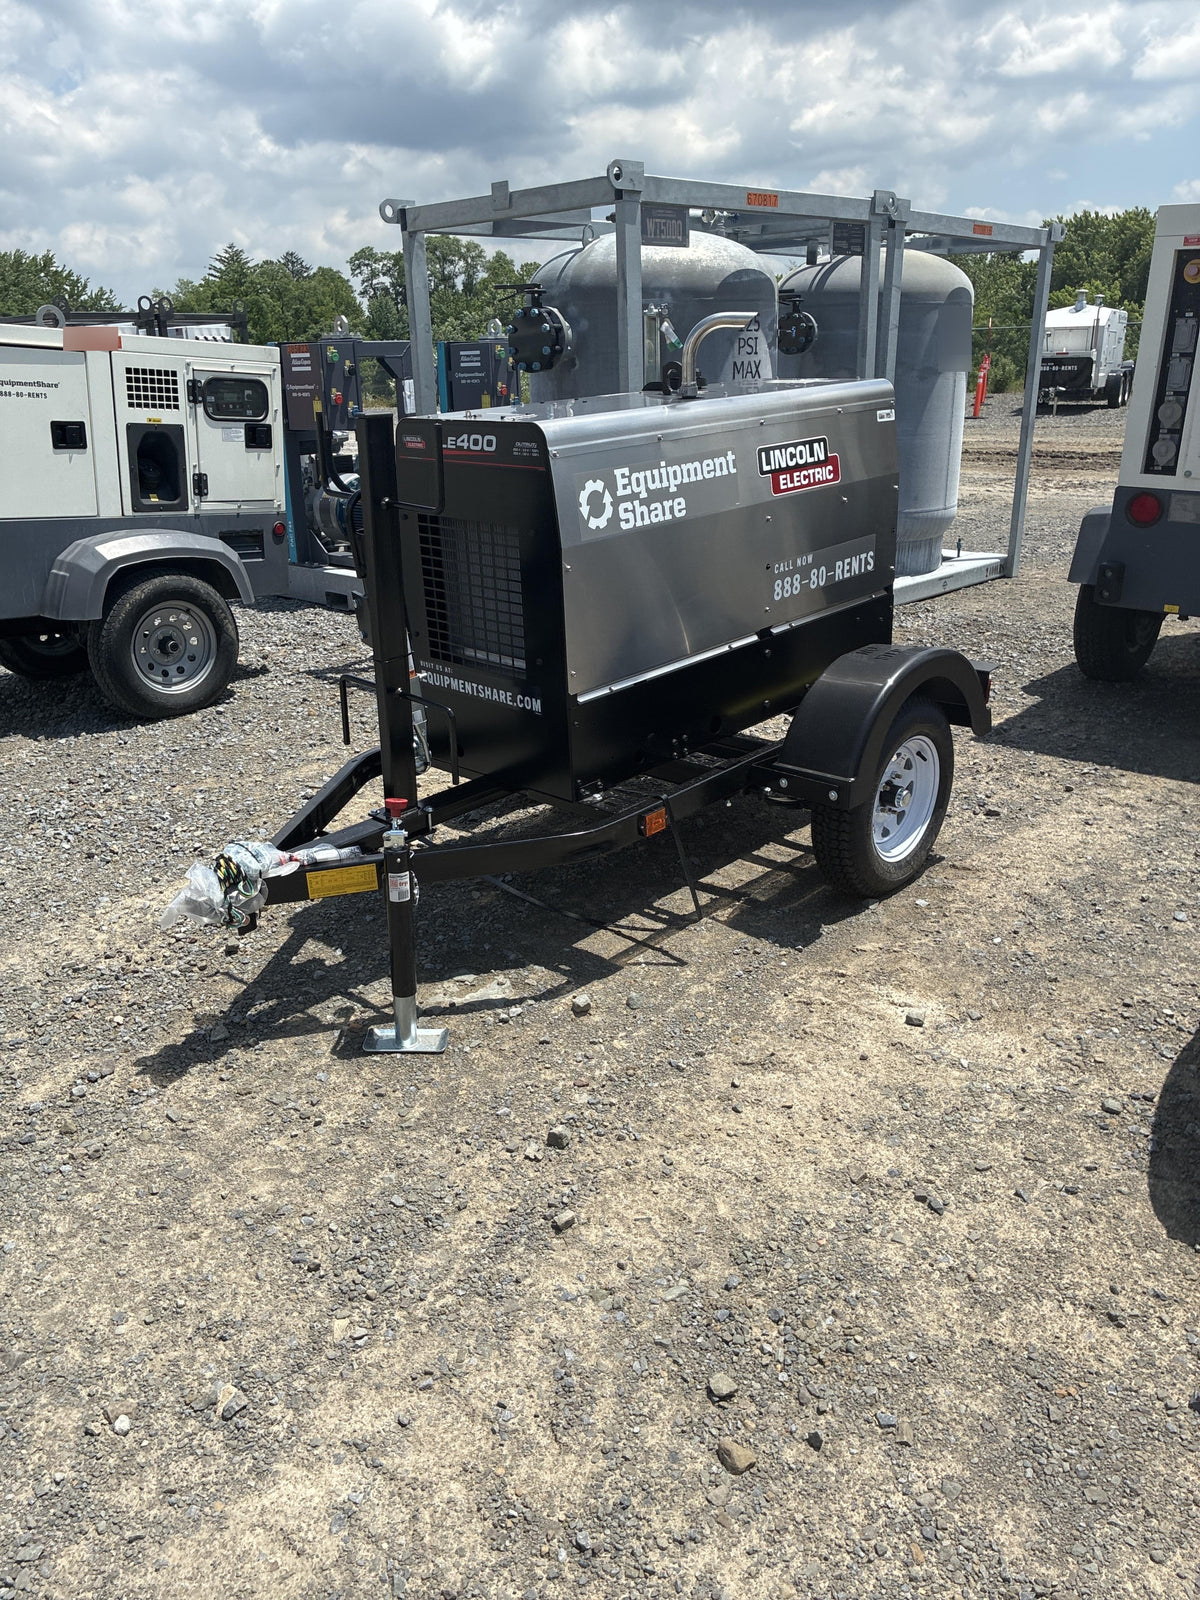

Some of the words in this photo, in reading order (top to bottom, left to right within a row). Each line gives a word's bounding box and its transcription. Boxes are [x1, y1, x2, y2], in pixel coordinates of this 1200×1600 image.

[747, 192, 778, 207] 670817
[737, 336, 758, 355] PSI
[732, 360, 761, 379] MAX
[0, 390, 48, 399] 888-80-RENTS
[761, 441, 826, 472] LINCOLN
[613, 450, 737, 499] Equipment
[779, 465, 834, 490] ELECTRIC
[618, 497, 687, 530] Share
[774, 559, 794, 574] CALL
[796, 553, 814, 568] NOW
[773, 550, 875, 601] 888-80-RENTS
